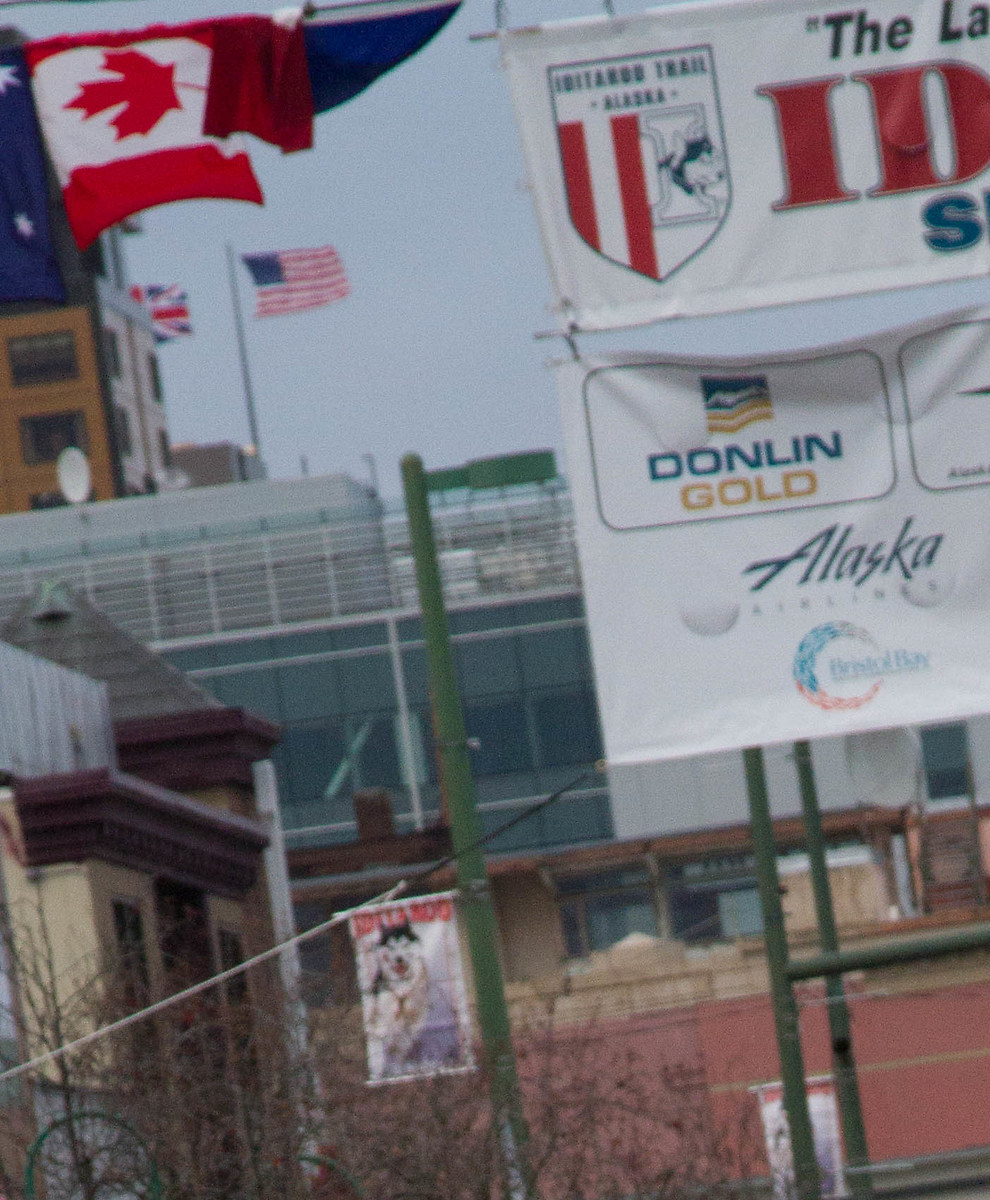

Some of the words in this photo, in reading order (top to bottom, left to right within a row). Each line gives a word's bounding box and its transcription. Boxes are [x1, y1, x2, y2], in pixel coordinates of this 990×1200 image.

[648, 431, 843, 482] DONLIN
[680, 469, 818, 512] GOLD
[741, 514, 945, 593] Alaska
